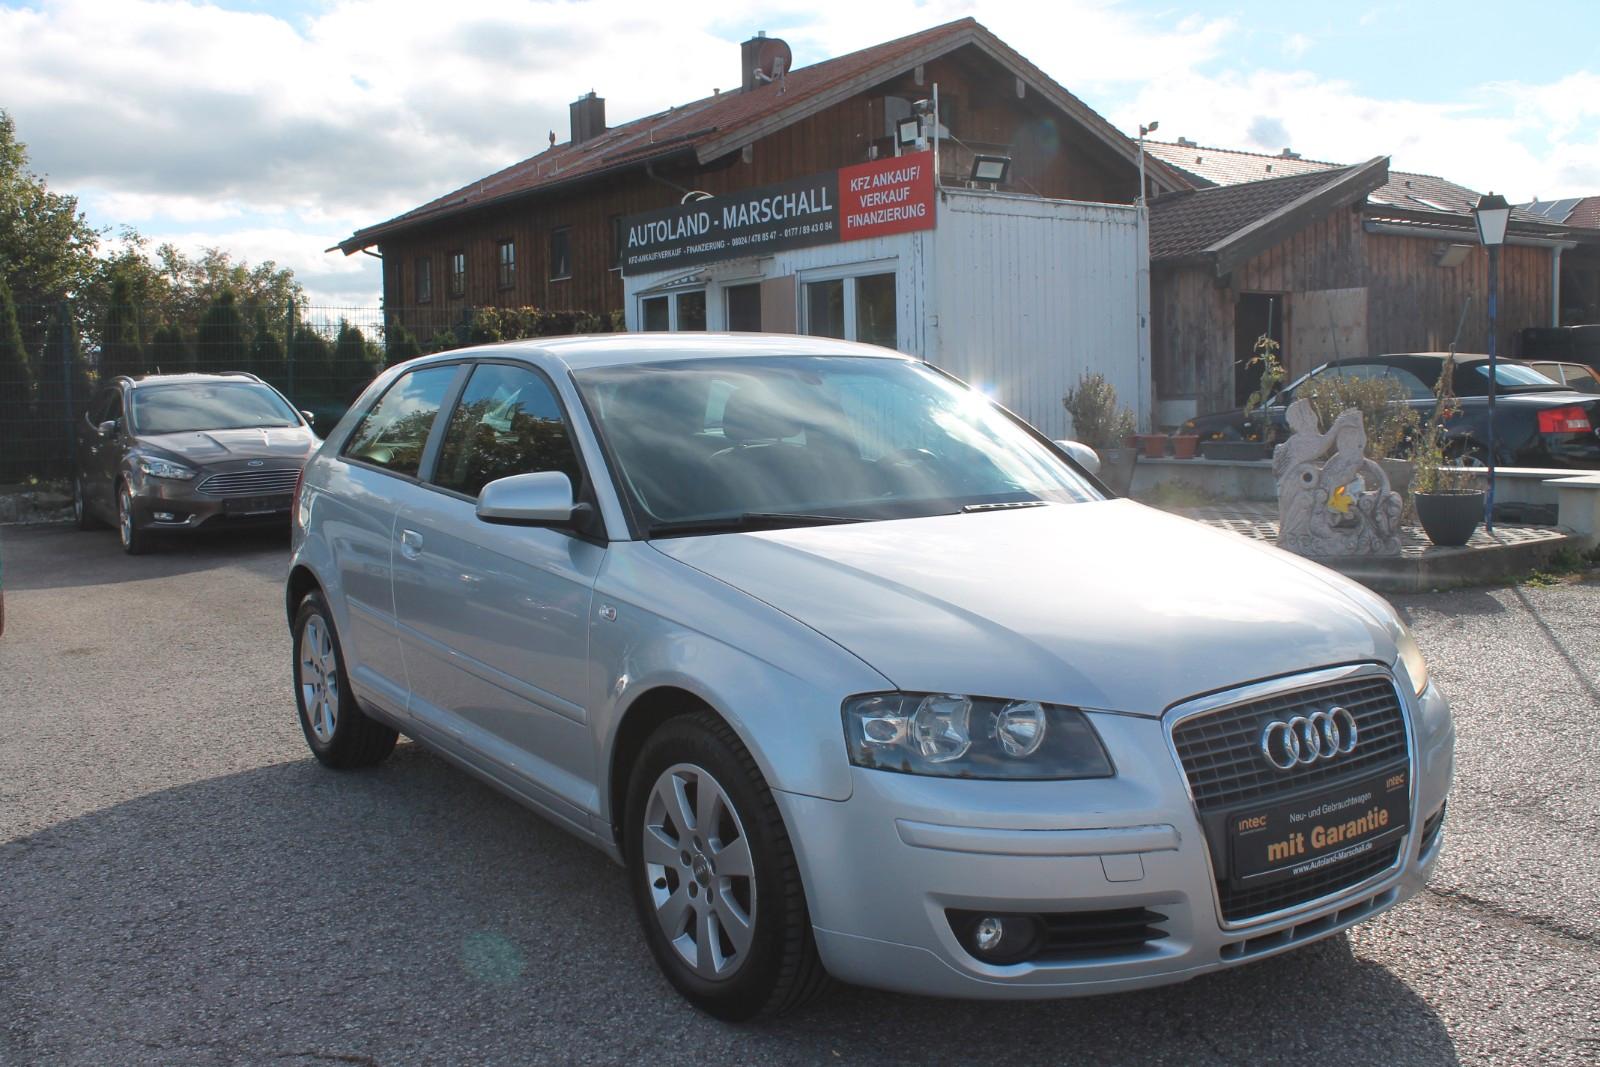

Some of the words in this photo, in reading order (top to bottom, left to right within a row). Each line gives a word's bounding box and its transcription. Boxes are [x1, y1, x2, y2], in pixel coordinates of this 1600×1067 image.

[850, 176, 871, 192] KFZ
[872, 166, 920, 188] ANKAUF/
[860, 187, 910, 208] VERKAUF
[628, 212, 709, 248] AUTOLAND
[723, 187, 833, 230] MARSCHALL
[847, 203, 926, 228] FINANZIERUNG
[686, 240, 725, 255] FINANZIERUNG
[784, 227, 798, 237] 0177
[1289, 812, 1307, 824] Neu-
[1308, 806, 1321, 818] und
[1322, 792, 1372, 814] Gebrauchtwagen
[1238, 815, 1267, 831] intec
[1267, 832, 1305, 862] mit
[1311, 806, 1389, 849] Garantie
[1292, 842, 1373, 875] www.Autoland-Marschall.de
